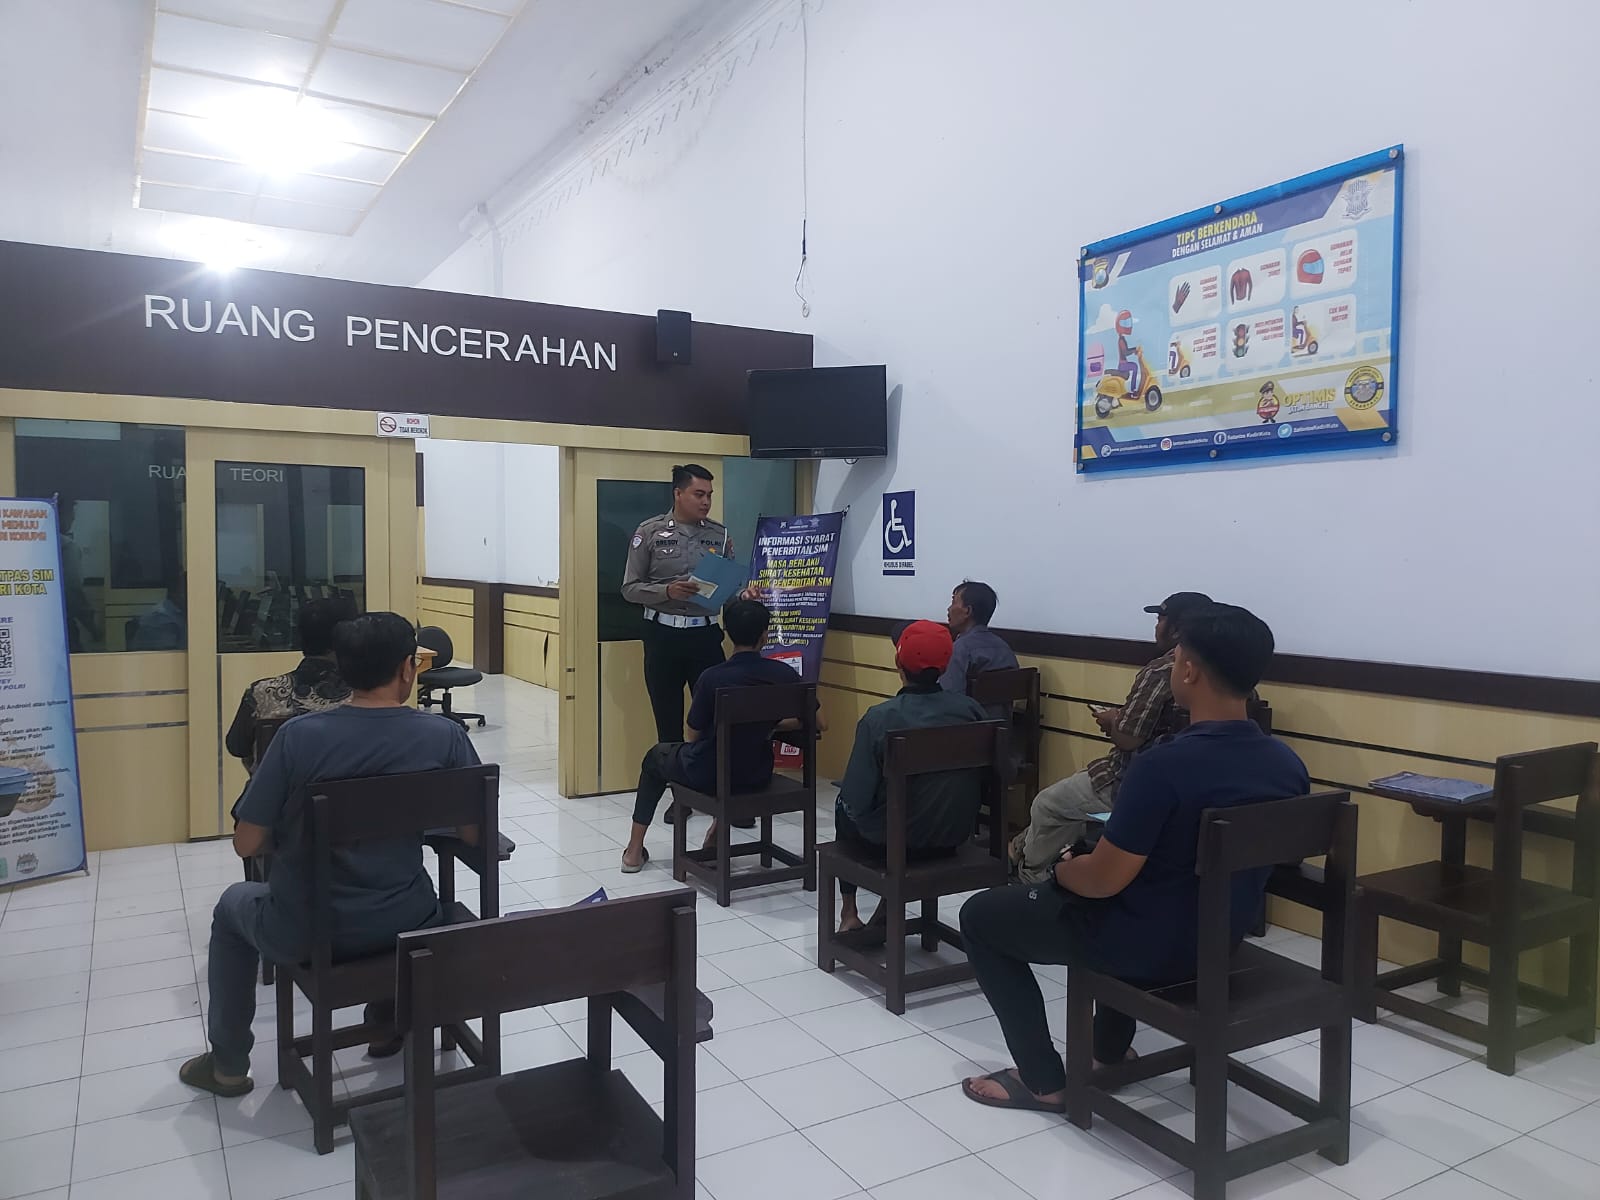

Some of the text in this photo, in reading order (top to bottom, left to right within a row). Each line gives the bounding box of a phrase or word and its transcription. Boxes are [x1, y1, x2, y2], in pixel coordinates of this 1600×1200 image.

[1176, 211, 1258, 246] TIPS BERKENDARA
[1172, 223, 1263, 257] DENGAN SELAMAT & AMAN
[144, 294, 617, 371] RUANG PENCERAHAN
[1284, 388, 1336, 406] OPTIMIS
[148, 464, 284, 482] RUA TEORI
[758, 533, 836, 546] INFORMASI SYARAT
[813, 544, 829, 554] SIM
[766, 558, 820, 568] MASA BERLAKU
[32, 568, 54, 581] SIM
[759, 567, 824, 579] SURAT KESEHATAN
[14, 583, 47, 595] KOTA
[772, 578, 816, 588] PENERBITAN
[817, 577, 833, 586] SIM
[7, 702, 31, 710] Android
